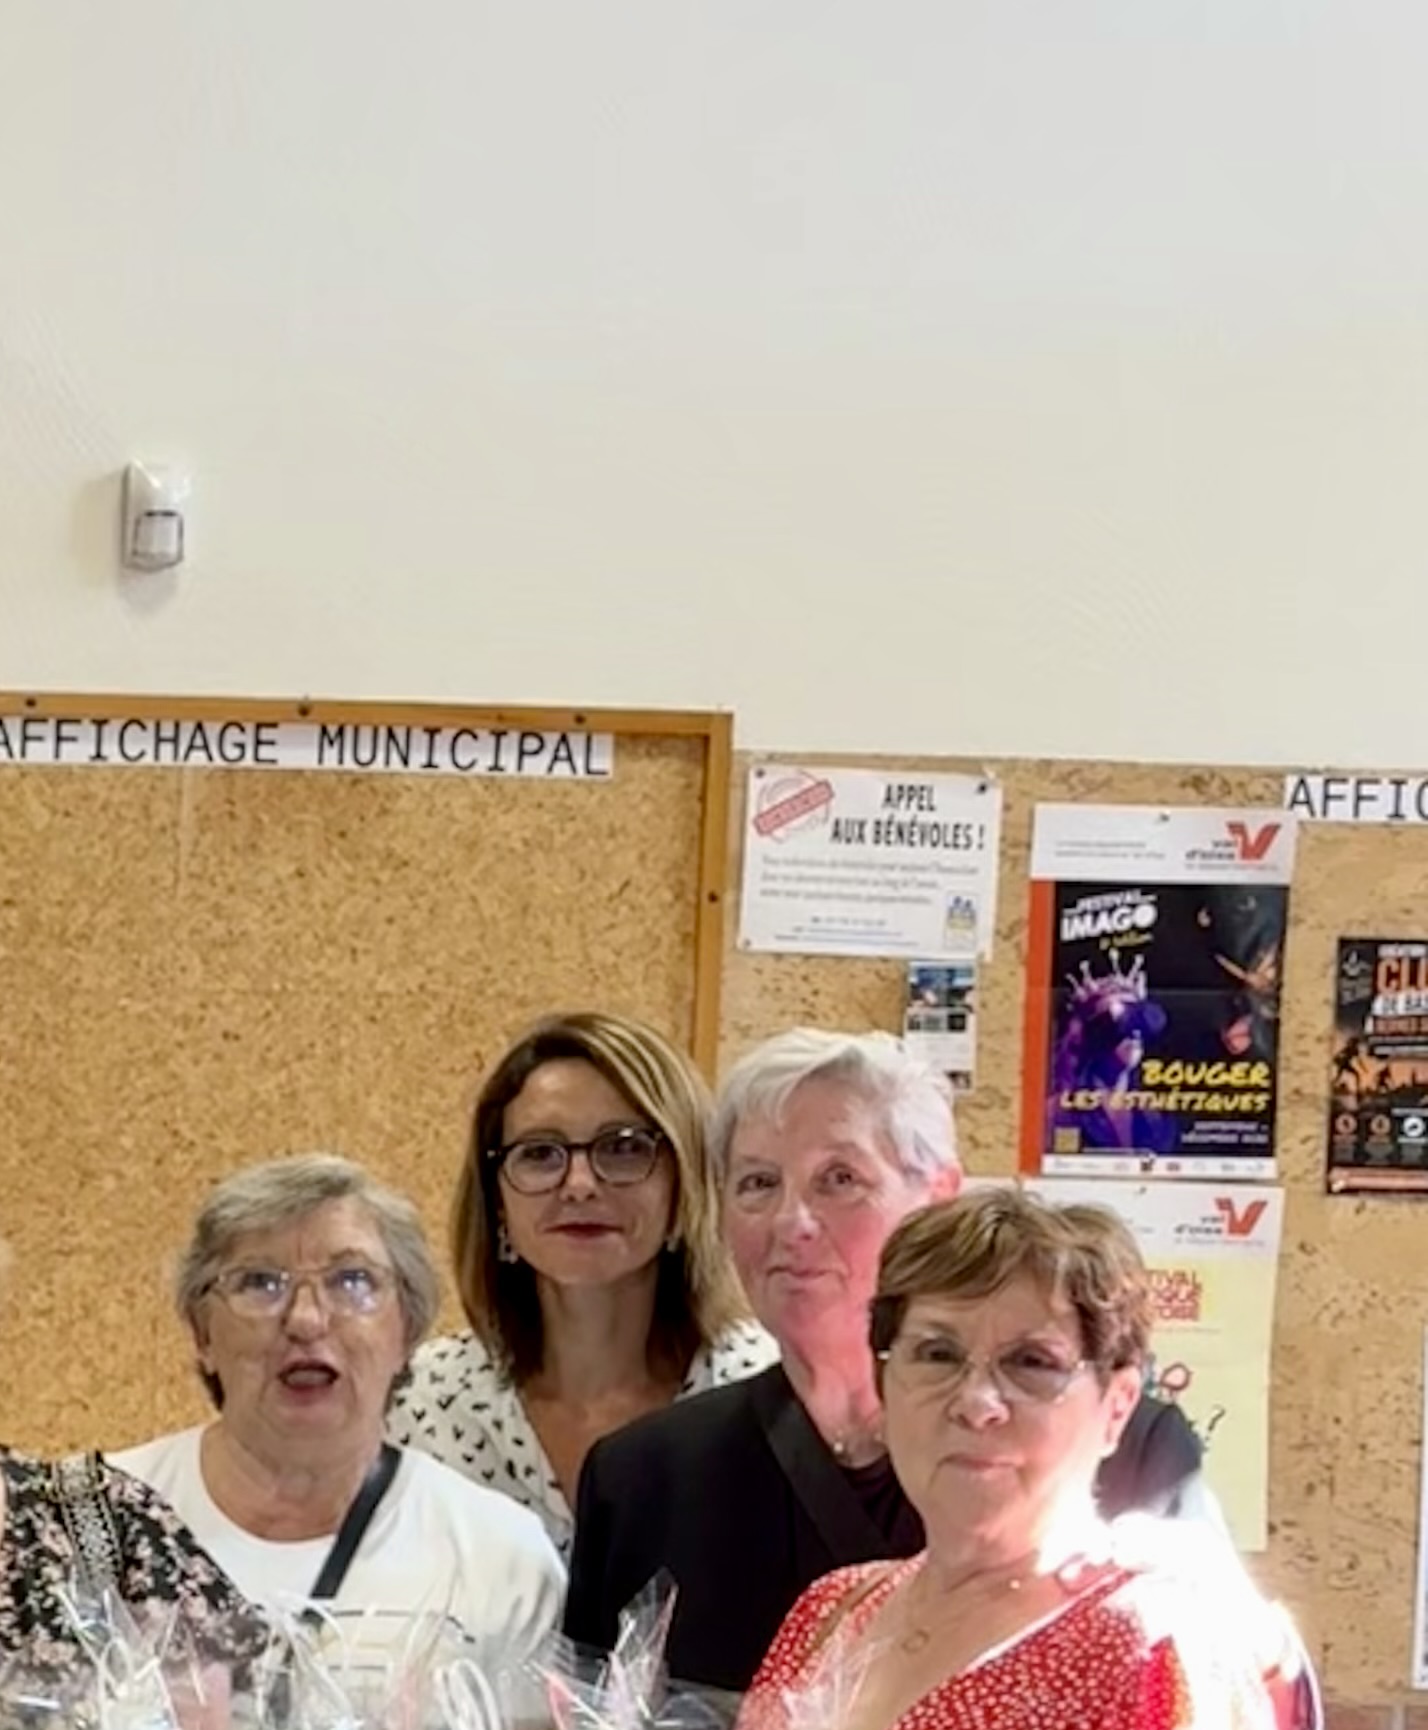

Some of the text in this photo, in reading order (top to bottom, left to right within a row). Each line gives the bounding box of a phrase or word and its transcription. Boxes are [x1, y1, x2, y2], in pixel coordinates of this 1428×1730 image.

[318, 724, 610, 775] MUNICIPAL
[881, 783, 938, 812] APPEL
[830, 817, 868, 846] AUX
[872, 813, 973, 850] BÉNÉVOLES
[1060, 903, 1158, 942] IMAGO
[1142, 1058, 1272, 1089] BOUGER
[1060, 1088, 1103, 1111] LES
